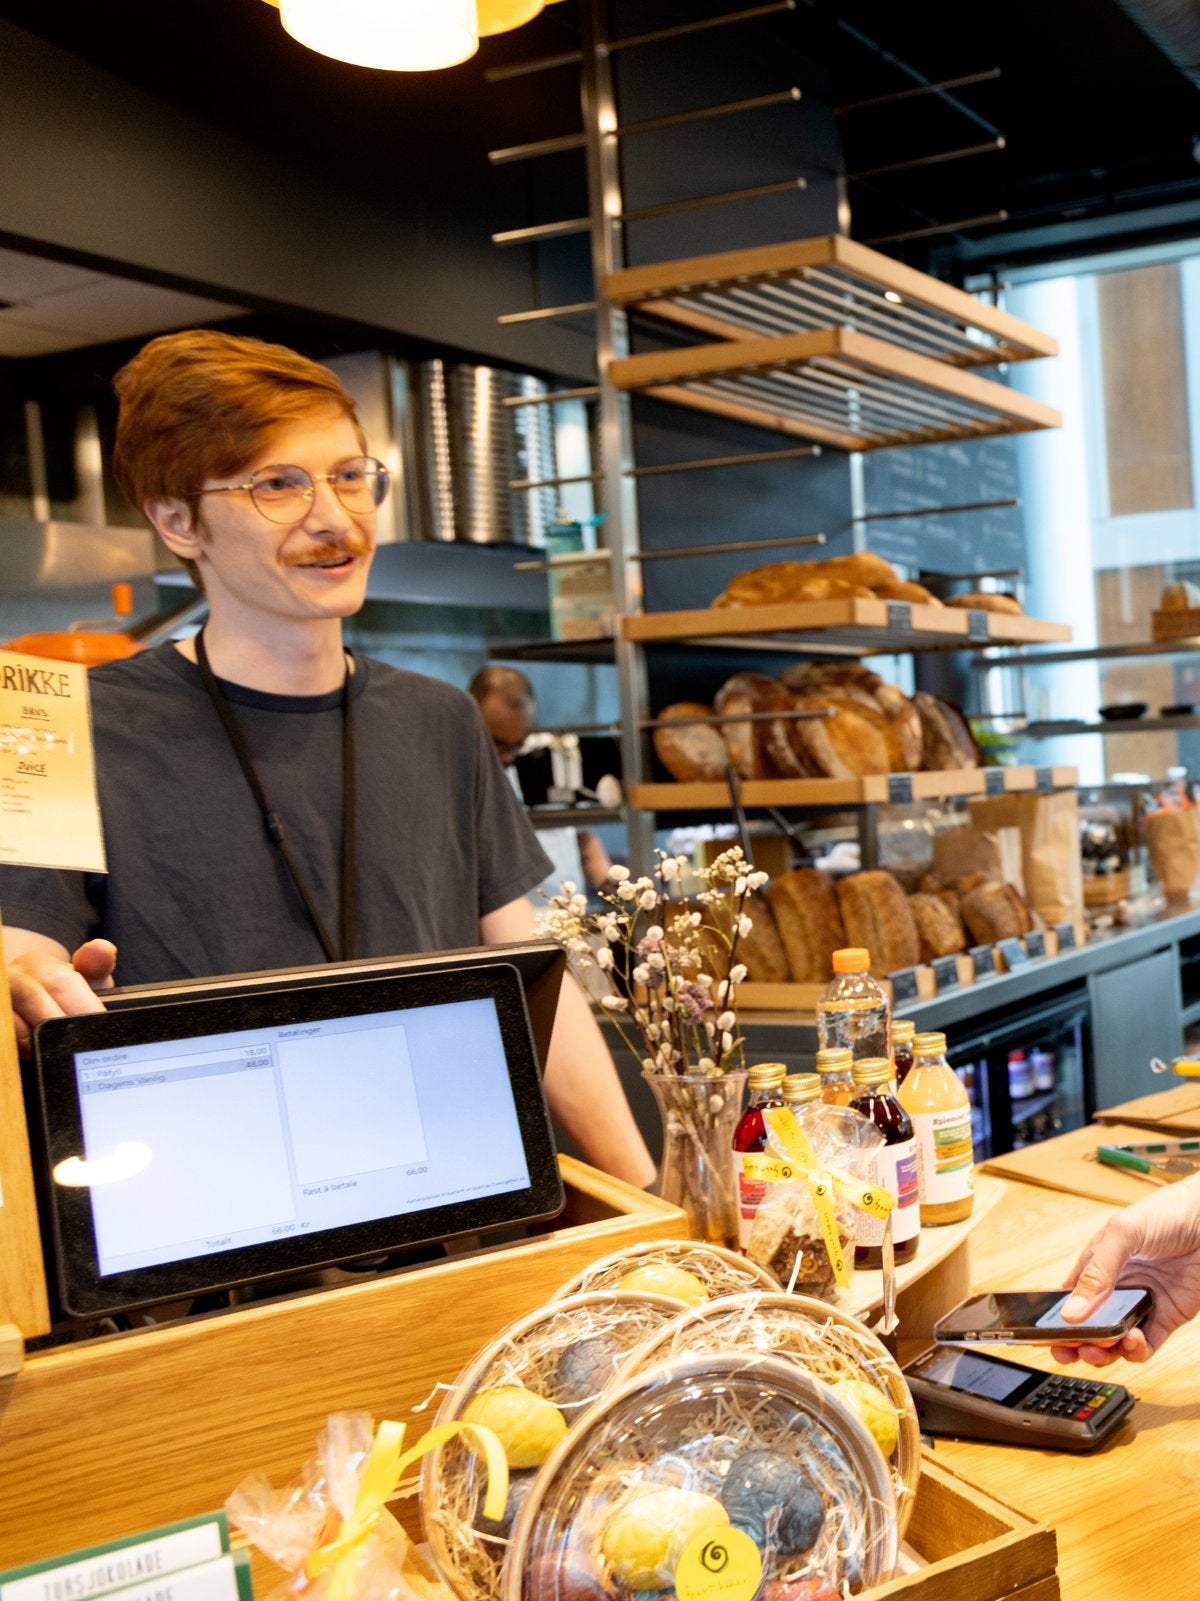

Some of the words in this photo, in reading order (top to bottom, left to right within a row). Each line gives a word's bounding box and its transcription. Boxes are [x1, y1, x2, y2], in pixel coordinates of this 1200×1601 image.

[0, 665, 71, 698] RIKKE
[82, 1056, 99, 1066] Din
[102, 1053, 128, 1064] ordre
[98, 1079, 135, 1092] Dagens
[303, 1186, 321, 1196] Rest
[206, 1237, 233, 1249] Totalt
